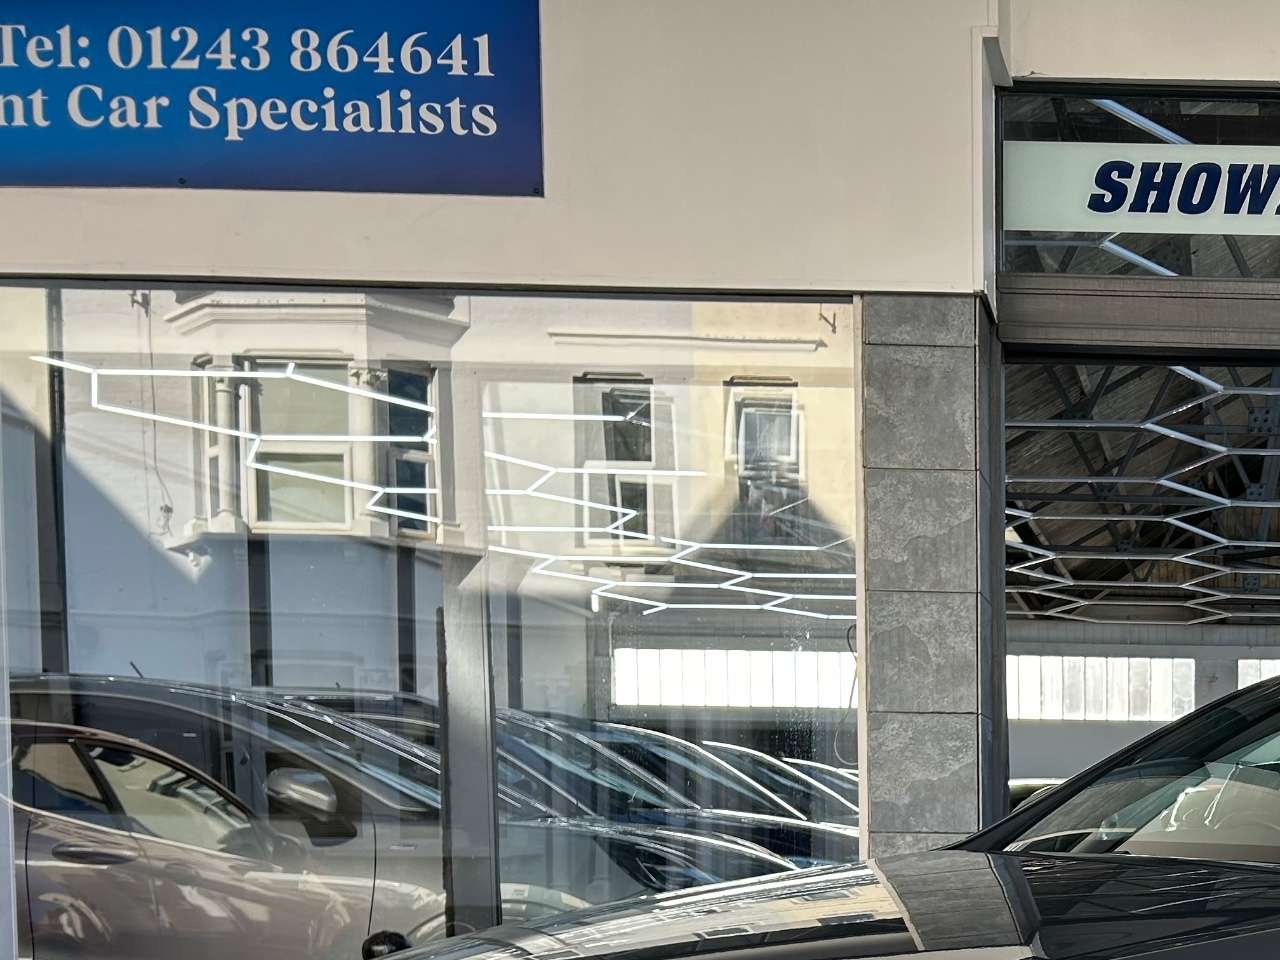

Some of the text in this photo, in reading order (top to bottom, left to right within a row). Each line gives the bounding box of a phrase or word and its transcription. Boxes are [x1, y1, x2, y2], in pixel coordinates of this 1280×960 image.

[0, 24, 496, 77] Tel: 01243 864641
[67, 84, 170, 129] Car
[188, 85, 498, 141] Specialists
